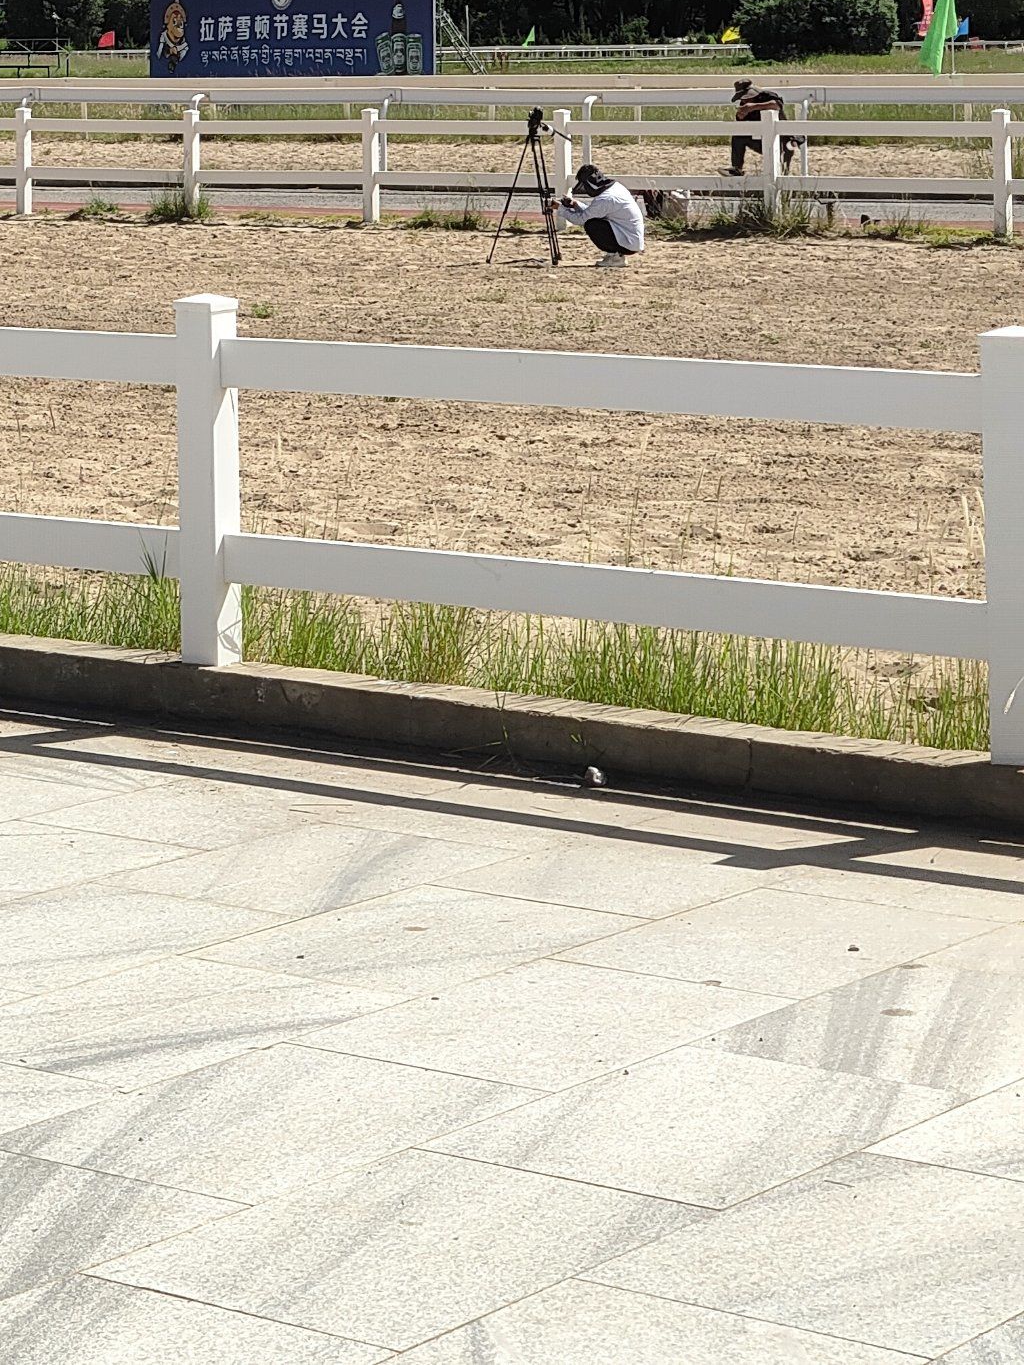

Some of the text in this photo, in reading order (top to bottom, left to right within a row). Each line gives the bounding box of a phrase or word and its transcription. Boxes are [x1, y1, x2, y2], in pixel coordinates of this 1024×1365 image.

[200, 12, 369, 42] 拉萨雪顿节赛马大会
